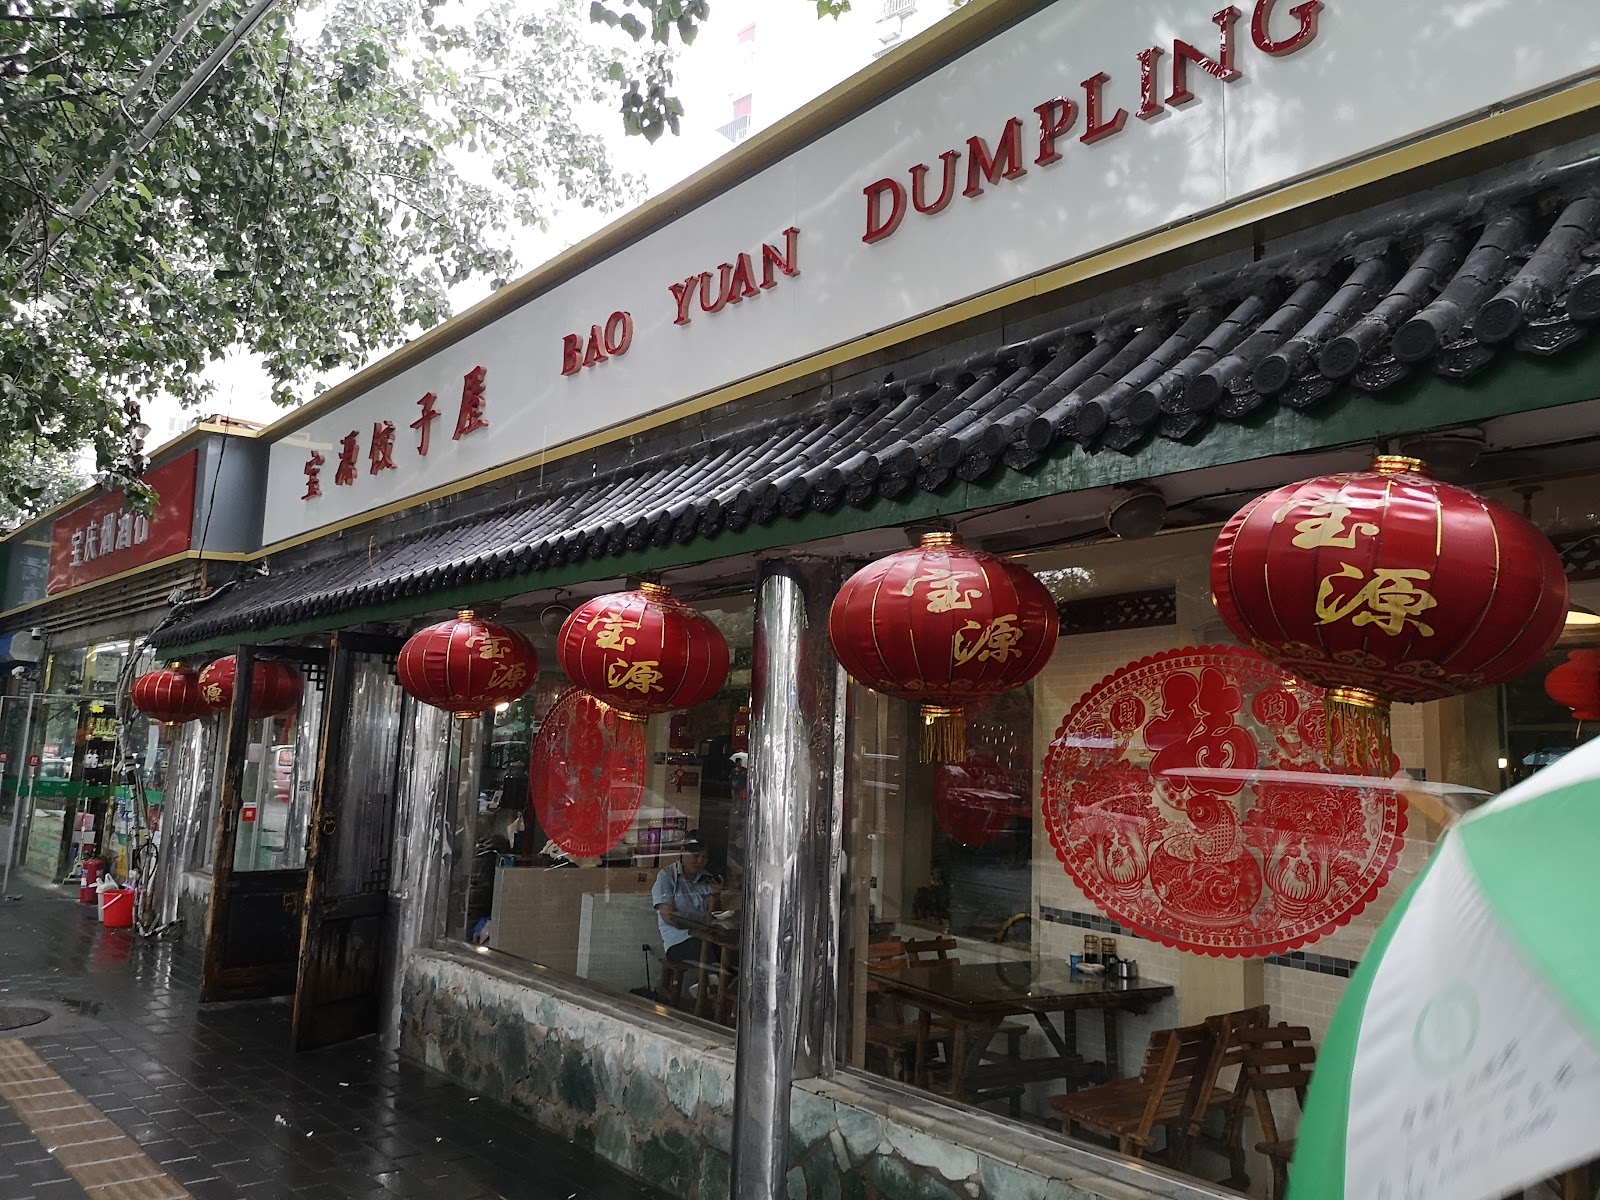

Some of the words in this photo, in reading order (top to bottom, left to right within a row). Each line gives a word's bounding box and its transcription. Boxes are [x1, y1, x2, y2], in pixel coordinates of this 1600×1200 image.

[561, 311, 633, 376] BAO
[668, 227, 801, 326] YUAN
[862, 0, 1325, 244] DUMPLING
[301, 365, 489, 501] 宝源饺子屋
[902, 567, 1023, 666] 宝源
[1273, 491, 1437, 637] 宝源
[587, 612, 665, 694] 宝源
